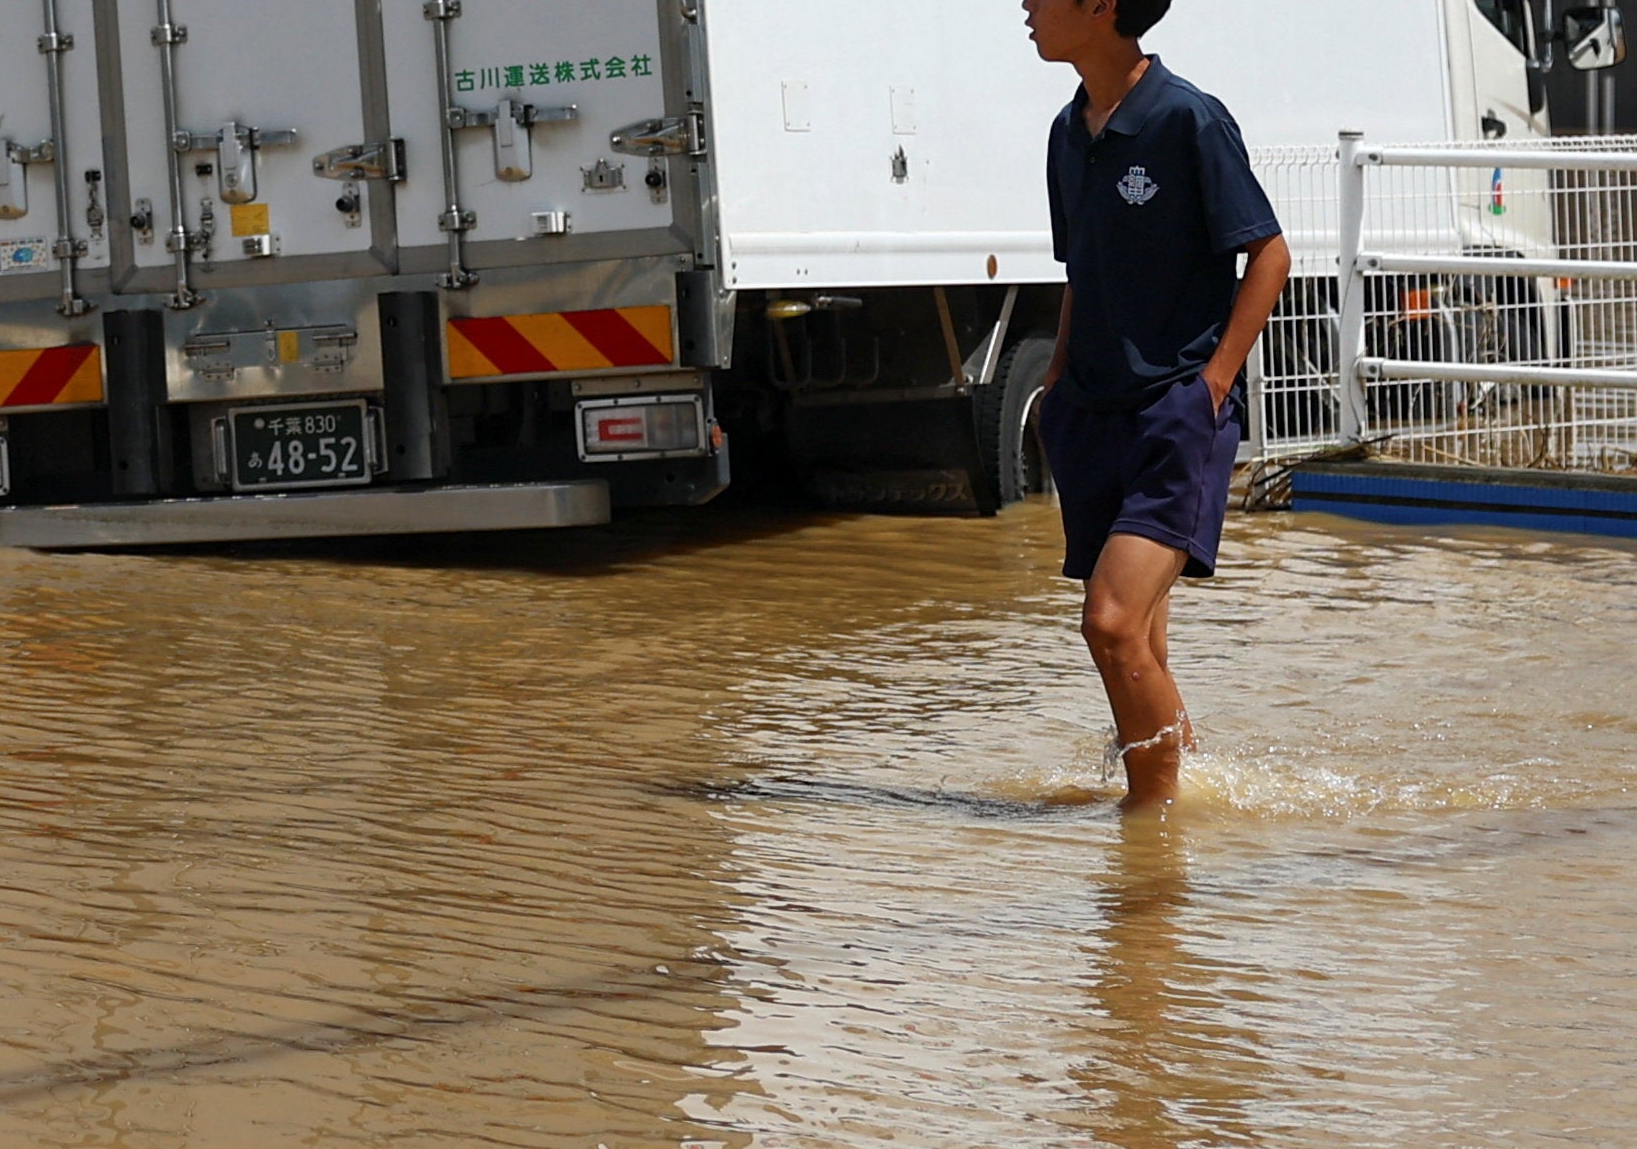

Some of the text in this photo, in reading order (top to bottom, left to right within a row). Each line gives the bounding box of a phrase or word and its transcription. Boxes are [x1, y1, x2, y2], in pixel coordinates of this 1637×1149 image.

[454, 53, 653, 92] 古川運送株式会社
[248, 436, 359, 476] あ 48-52
